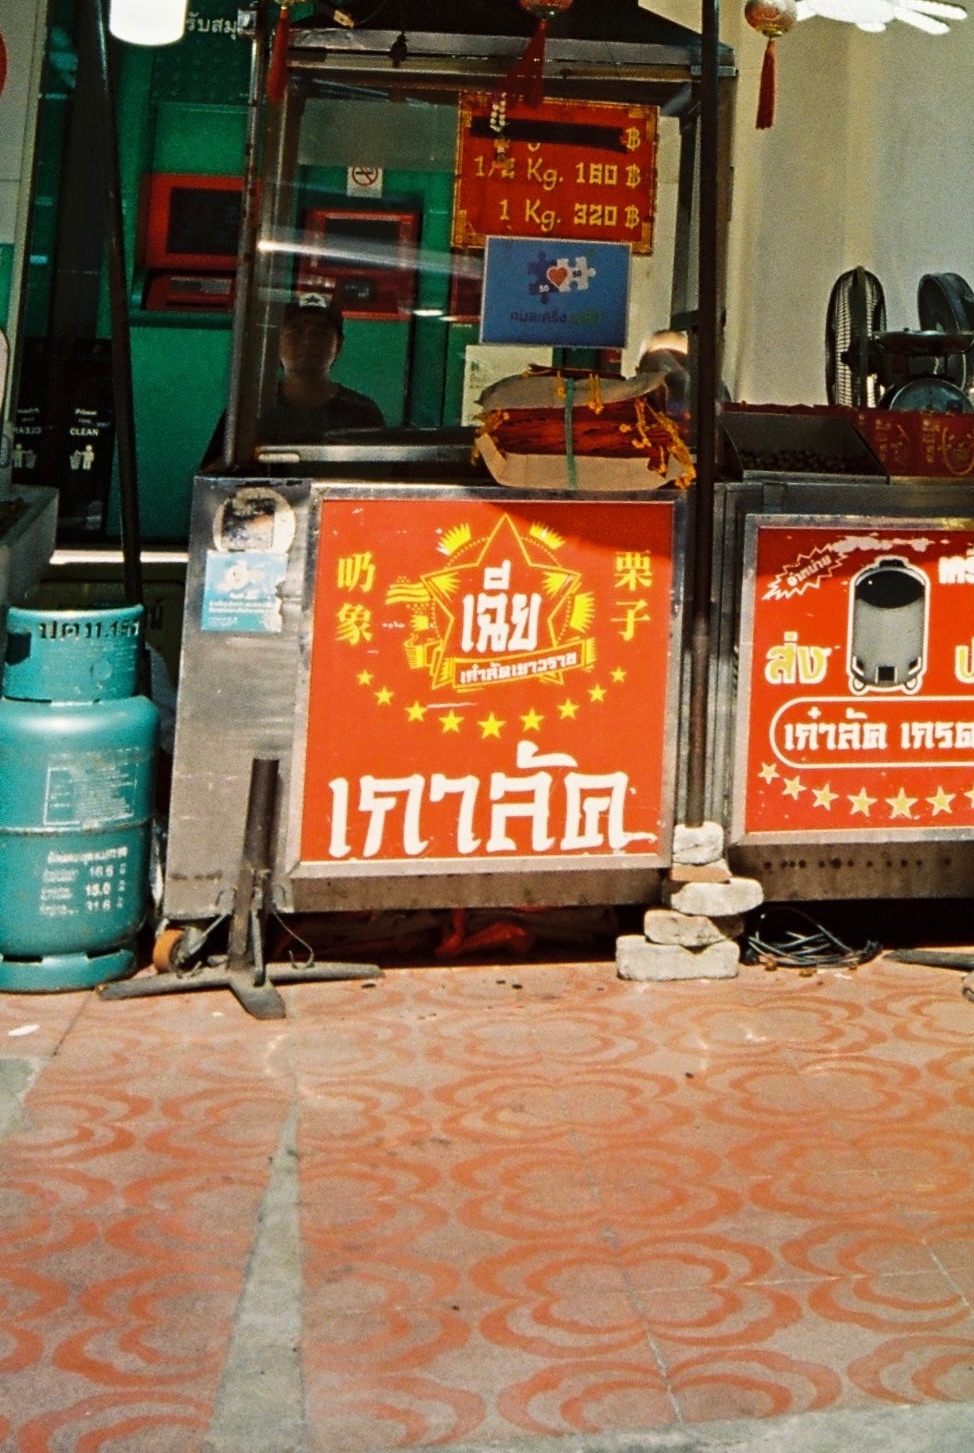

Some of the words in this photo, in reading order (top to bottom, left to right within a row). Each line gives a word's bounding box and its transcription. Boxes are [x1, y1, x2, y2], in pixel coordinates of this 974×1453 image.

[527, 157, 565, 191] Kg.
[524, 198, 562, 233] Kg.
[573, 202, 618, 227] 320
[69, 427, 100, 437] CLEAN
[611, 551, 653, 642] 栗子
[764, 631, 833, 685] ส่ง
[328, 740, 657, 857] เกาลัด
